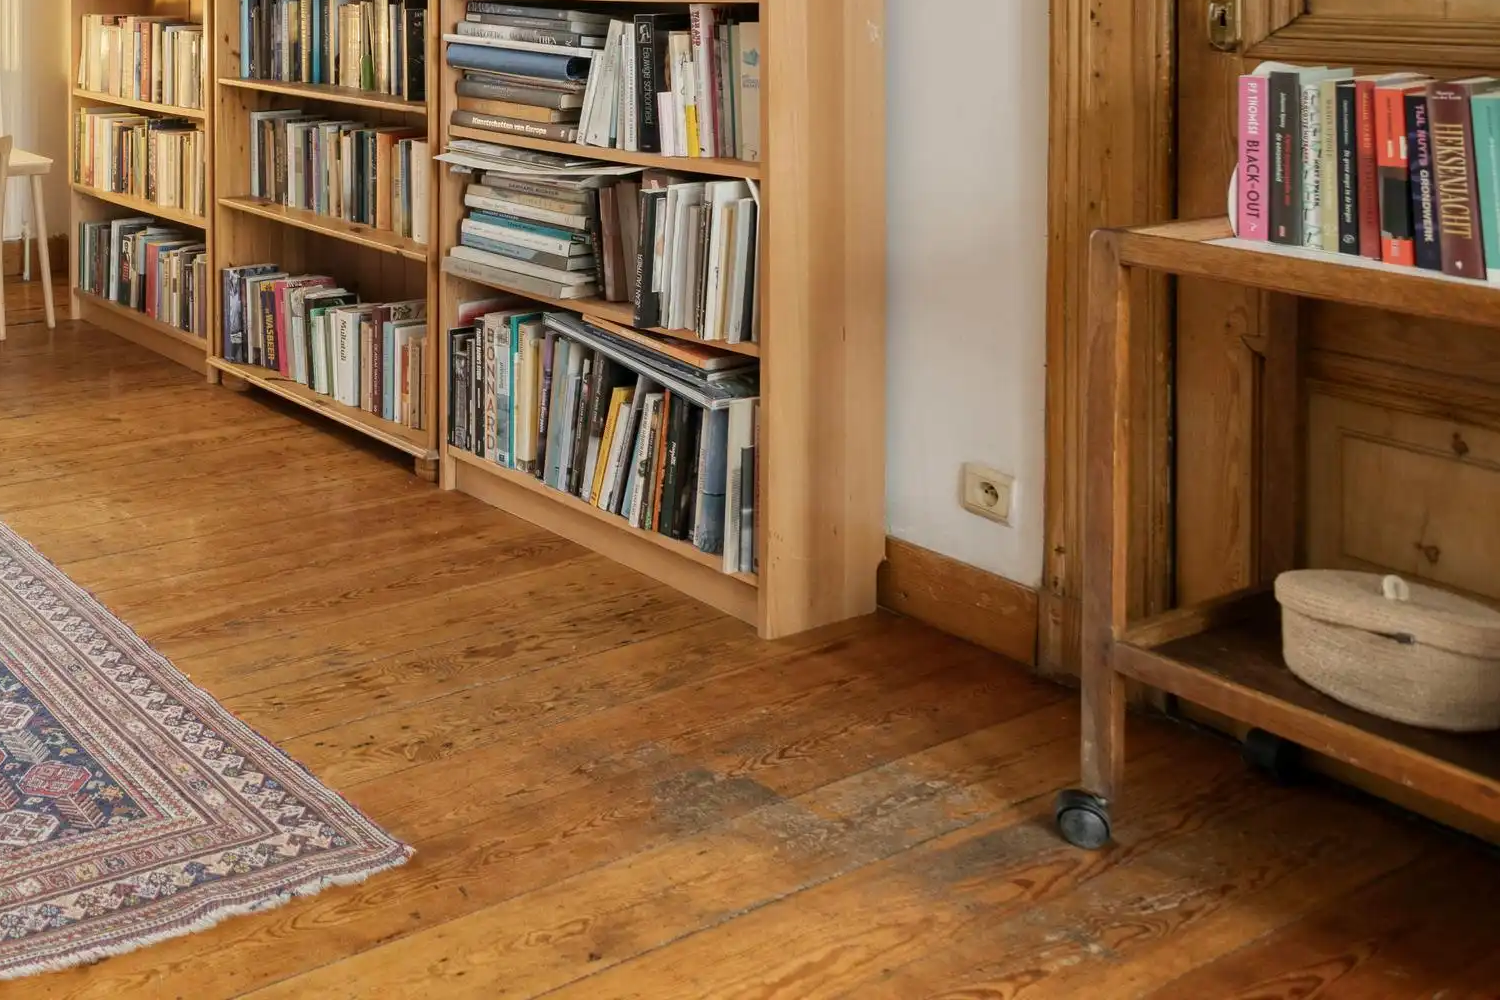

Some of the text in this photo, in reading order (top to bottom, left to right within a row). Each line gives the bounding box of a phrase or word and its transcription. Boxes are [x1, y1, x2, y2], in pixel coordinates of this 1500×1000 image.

[642, 46, 653, 124] Eeuwige schoonheid
[471, 116, 548, 135] Kunstschatten van Europa
[1245, 139, 1260, 219] BLACK-OUT
[1415, 104, 1434, 242] TIJL NUYTS GRONDWERK
[1433, 122, 1472, 240] HEKSENJACHT
[635, 253, 643, 288] FAUTRIER
[265, 314, 275, 361] WASBEER
[486, 327, 495, 451] BONNARD
